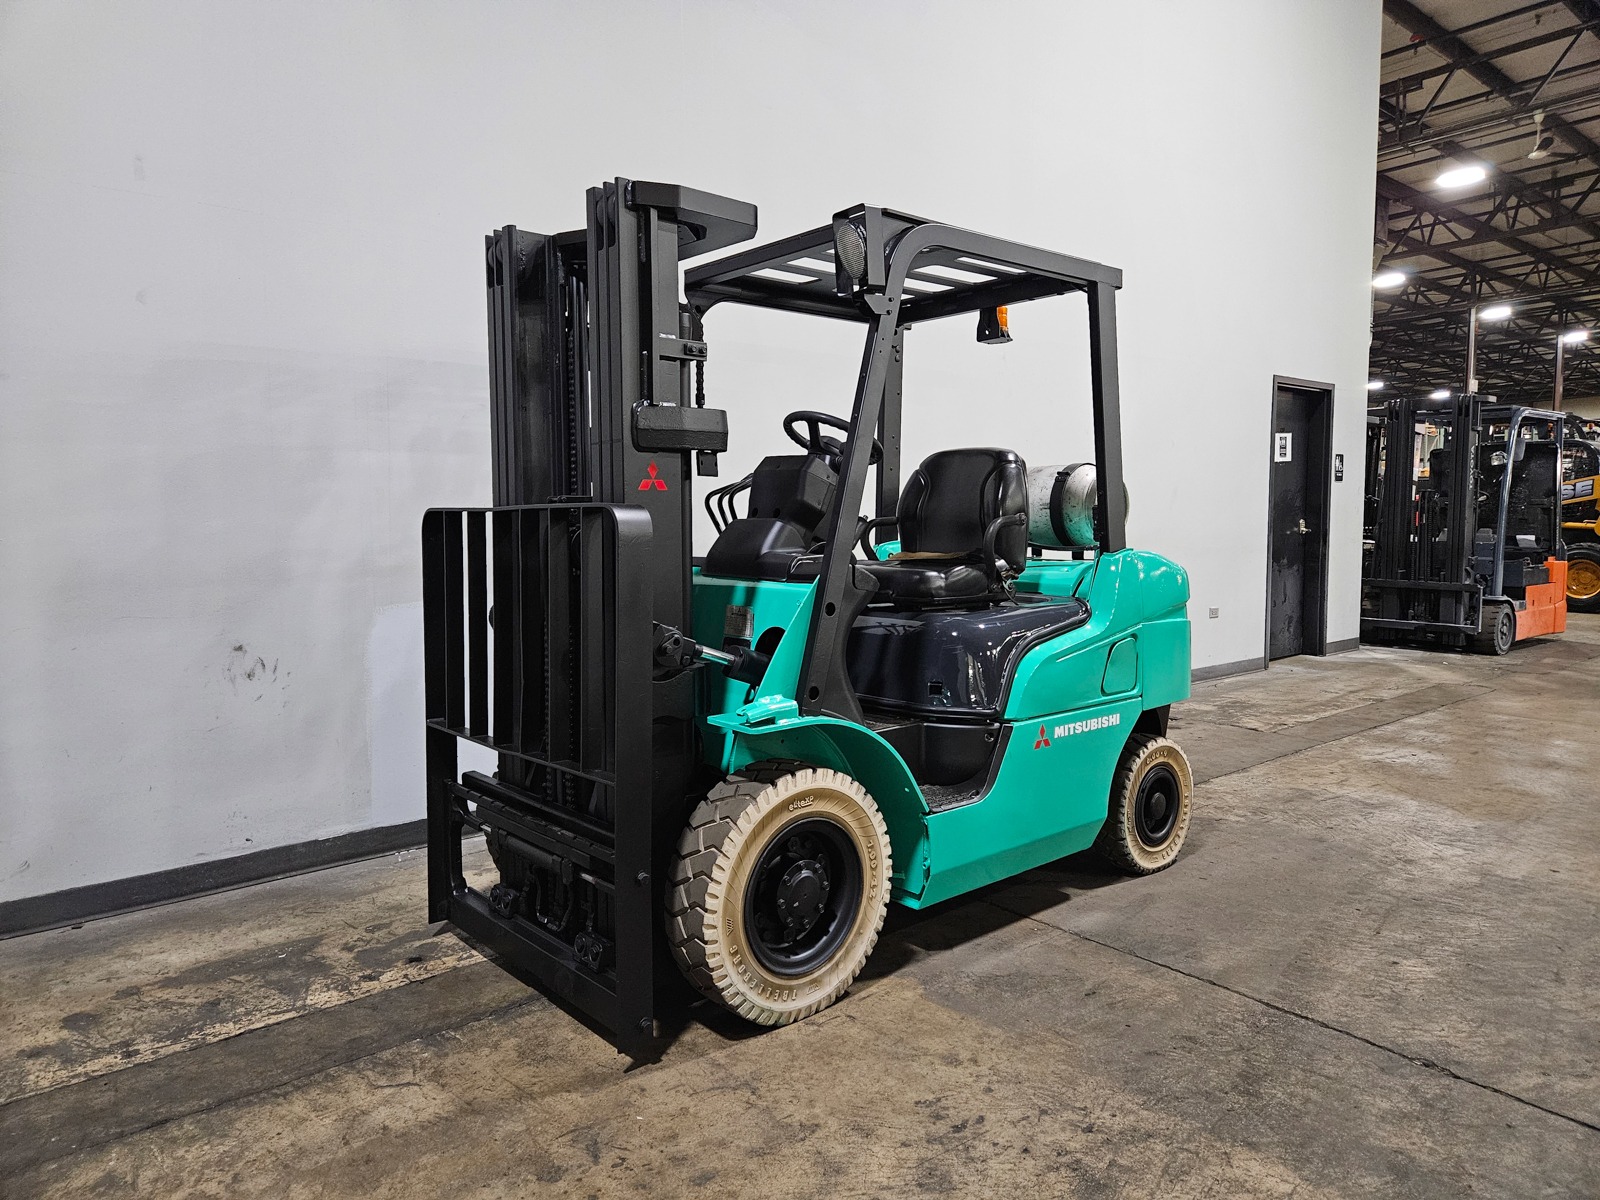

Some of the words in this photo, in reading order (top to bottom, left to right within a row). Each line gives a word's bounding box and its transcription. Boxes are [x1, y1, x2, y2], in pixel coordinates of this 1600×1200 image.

[1561, 479, 1594, 500] SE
[1053, 713, 1120, 739] MITSUBISHI
[729, 944, 797, 1001] TRELLEBORG
